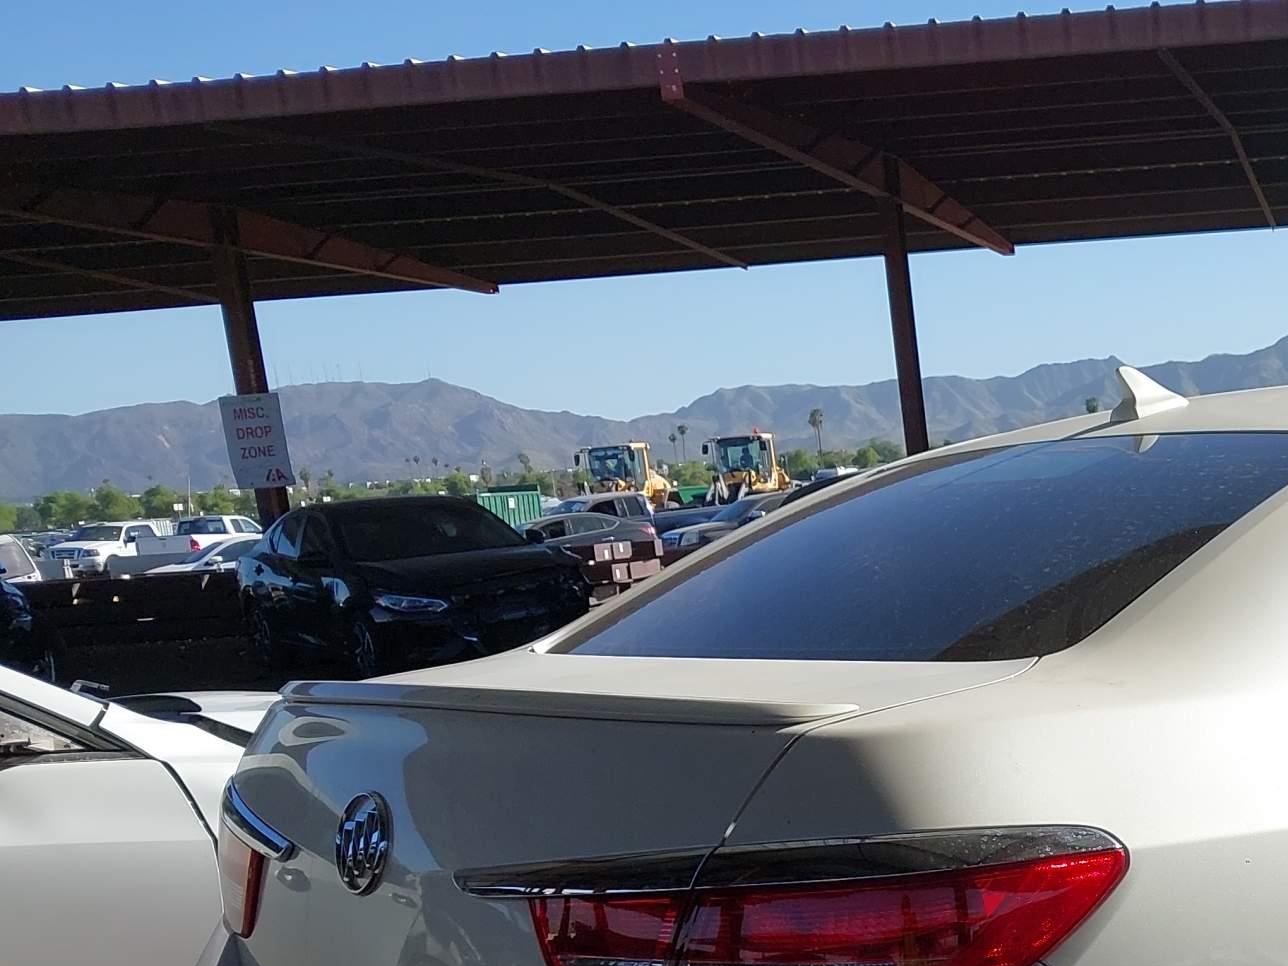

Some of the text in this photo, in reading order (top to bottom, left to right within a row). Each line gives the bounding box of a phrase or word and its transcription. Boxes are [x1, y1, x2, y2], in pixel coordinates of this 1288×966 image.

[232, 407, 270, 421] MISC.
[236, 425, 272, 440] DROP
[240, 445, 276, 459] ZONE
